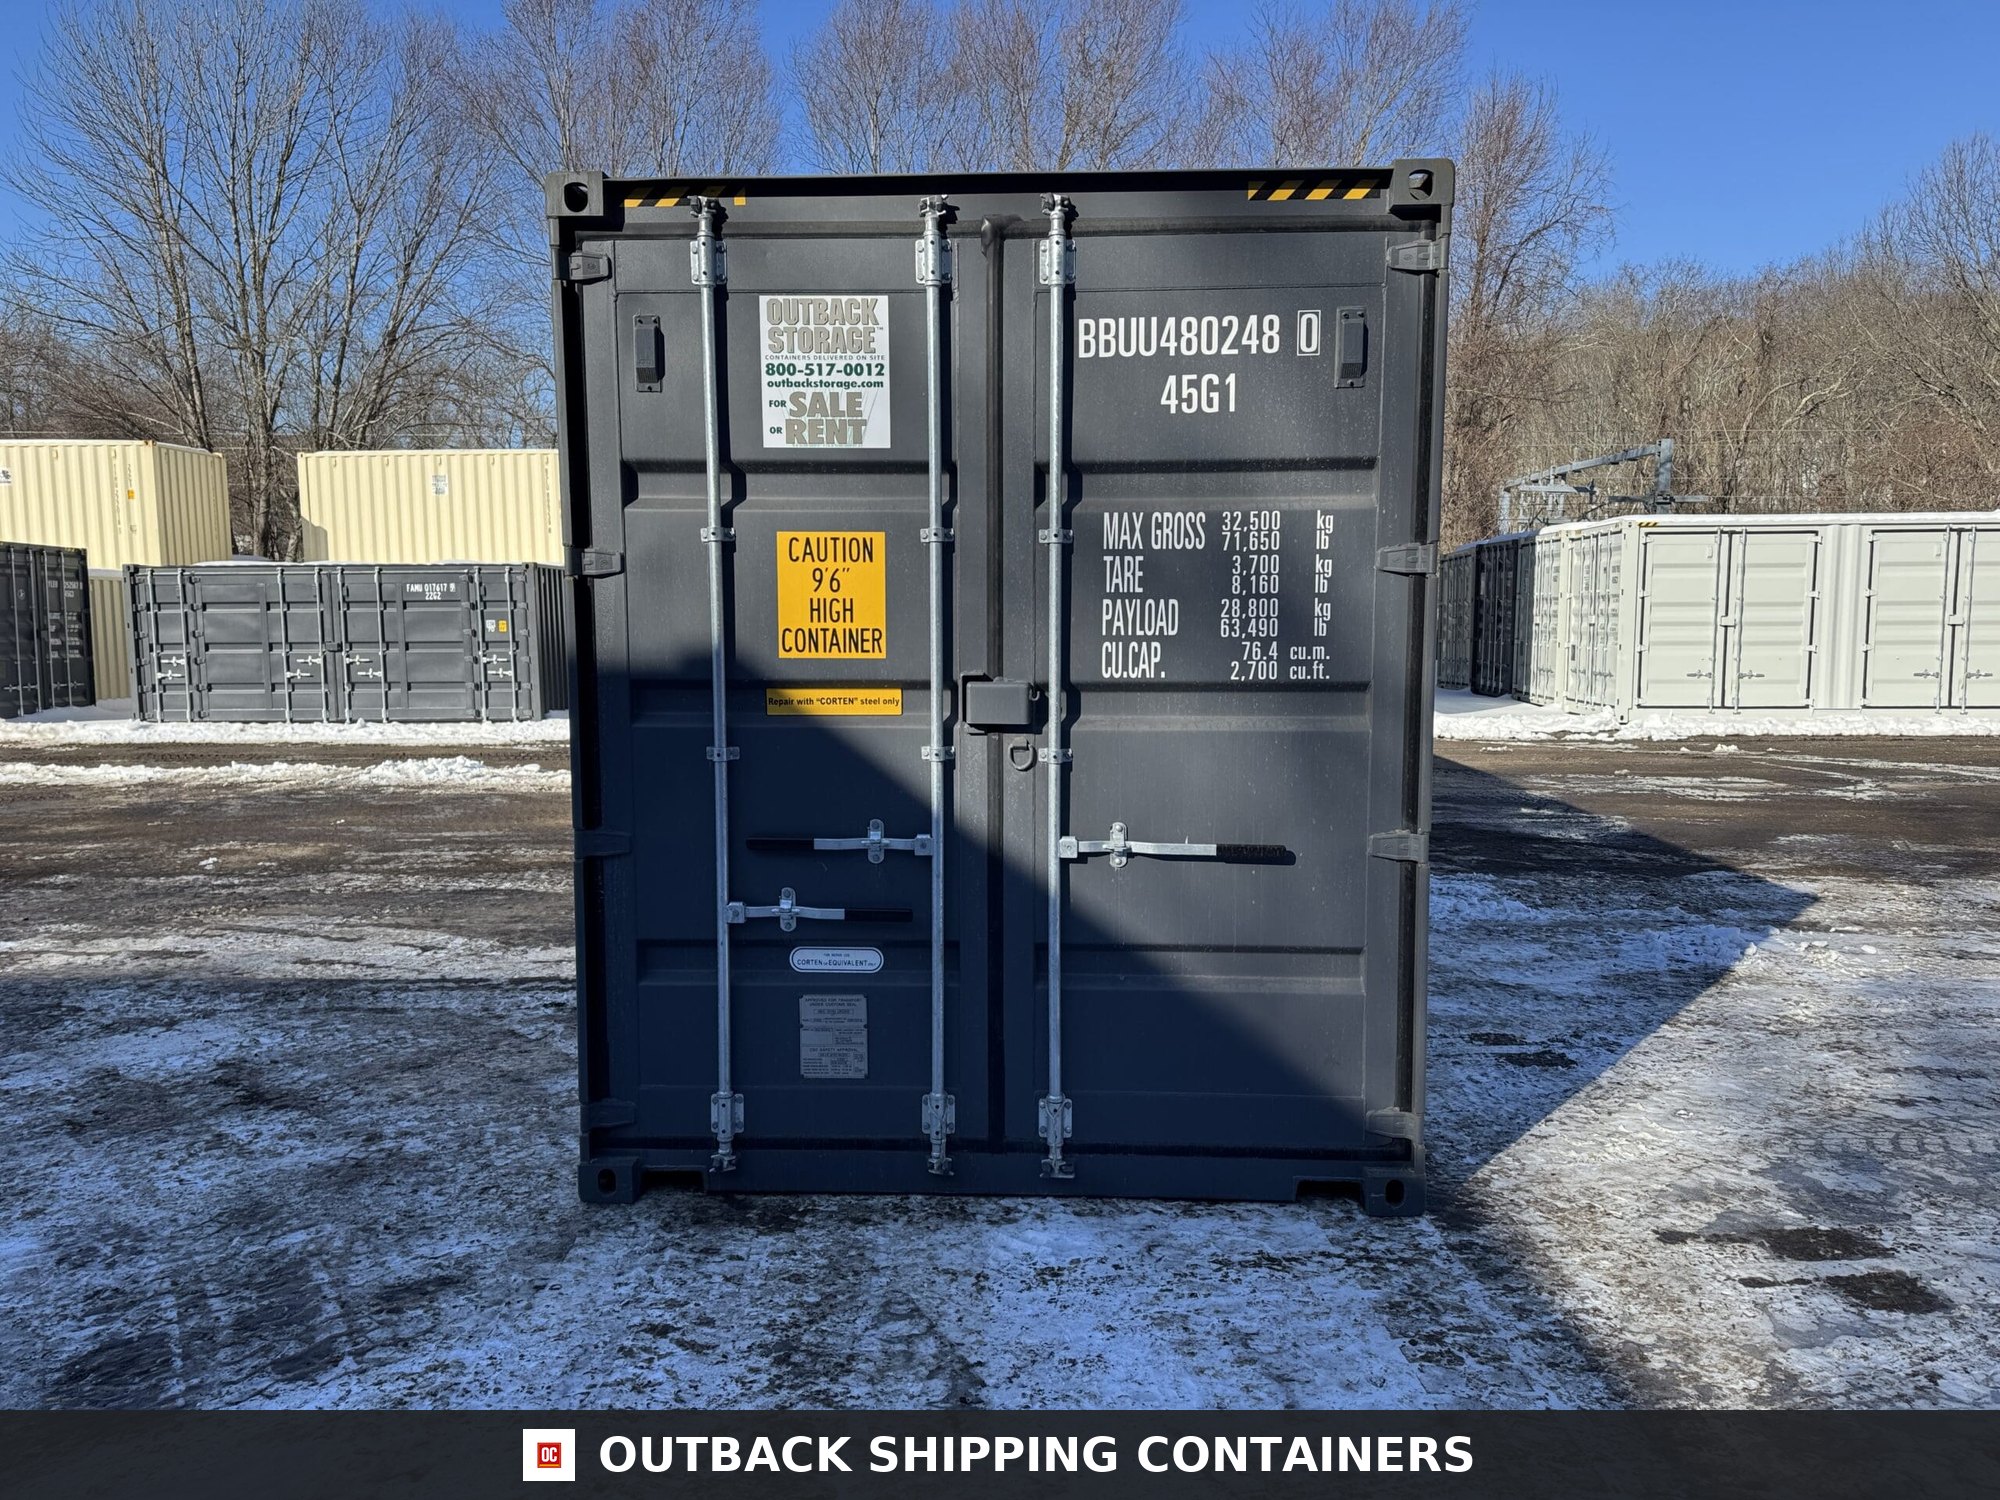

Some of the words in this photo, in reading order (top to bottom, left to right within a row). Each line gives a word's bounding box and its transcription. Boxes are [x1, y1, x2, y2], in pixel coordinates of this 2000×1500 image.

[766, 298, 879, 326] OUTBACK
[767, 326, 876, 354] STORAGE
[1078, 314, 1280, 358] BBUU480248
[1300, 313, 1319, 352] 0
[765, 363, 885, 376] 800-517-0012
[767, 378, 884, 389] outbackstorage.com
[1160, 373, 1236, 414] 45G1
[789, 391, 863, 418] SALE
[785, 419, 868, 444] RENT
[1103, 511, 1144, 550] MAX
[1151, 511, 1206, 550] GROSS
[1222, 510, 1281, 532] 32,500
[1316, 510, 1334, 533] kg
[1222, 531, 1281, 551] 71,650
[1316, 529, 1329, 550] lb
[788, 536, 874, 563] CAUTION
[1103, 555, 1144, 593] TARE
[1232, 554, 1280, 575] 3,700
[1315, 554, 1333, 577] kg
[1231, 574, 1279, 595] 8,160
[1315, 574, 1328, 594] lb
[809, 598, 854, 623] HIGH
[1101, 599, 1179, 636] PAYLOAD
[1220, 598, 1279, 619] 28,800
[1314, 598, 1332, 621] kg
[781, 628, 883, 653] CONTAINER
[1220, 618, 1279, 638] 63,490
[1313, 617, 1327, 637] lb
[1101, 641, 1166, 679] CU.CAP.
[1241, 641, 1278, 660] 76.4
[1289, 645, 1331, 660] cu.m.
[1230, 661, 1278, 681] 2,700
[1289, 664, 1330, 680] cu.ft.
[768, 697, 794, 707] Repair
[797, 697, 814, 705] with
[860, 697, 880, 705] steel
[883, 697, 900, 706] only
